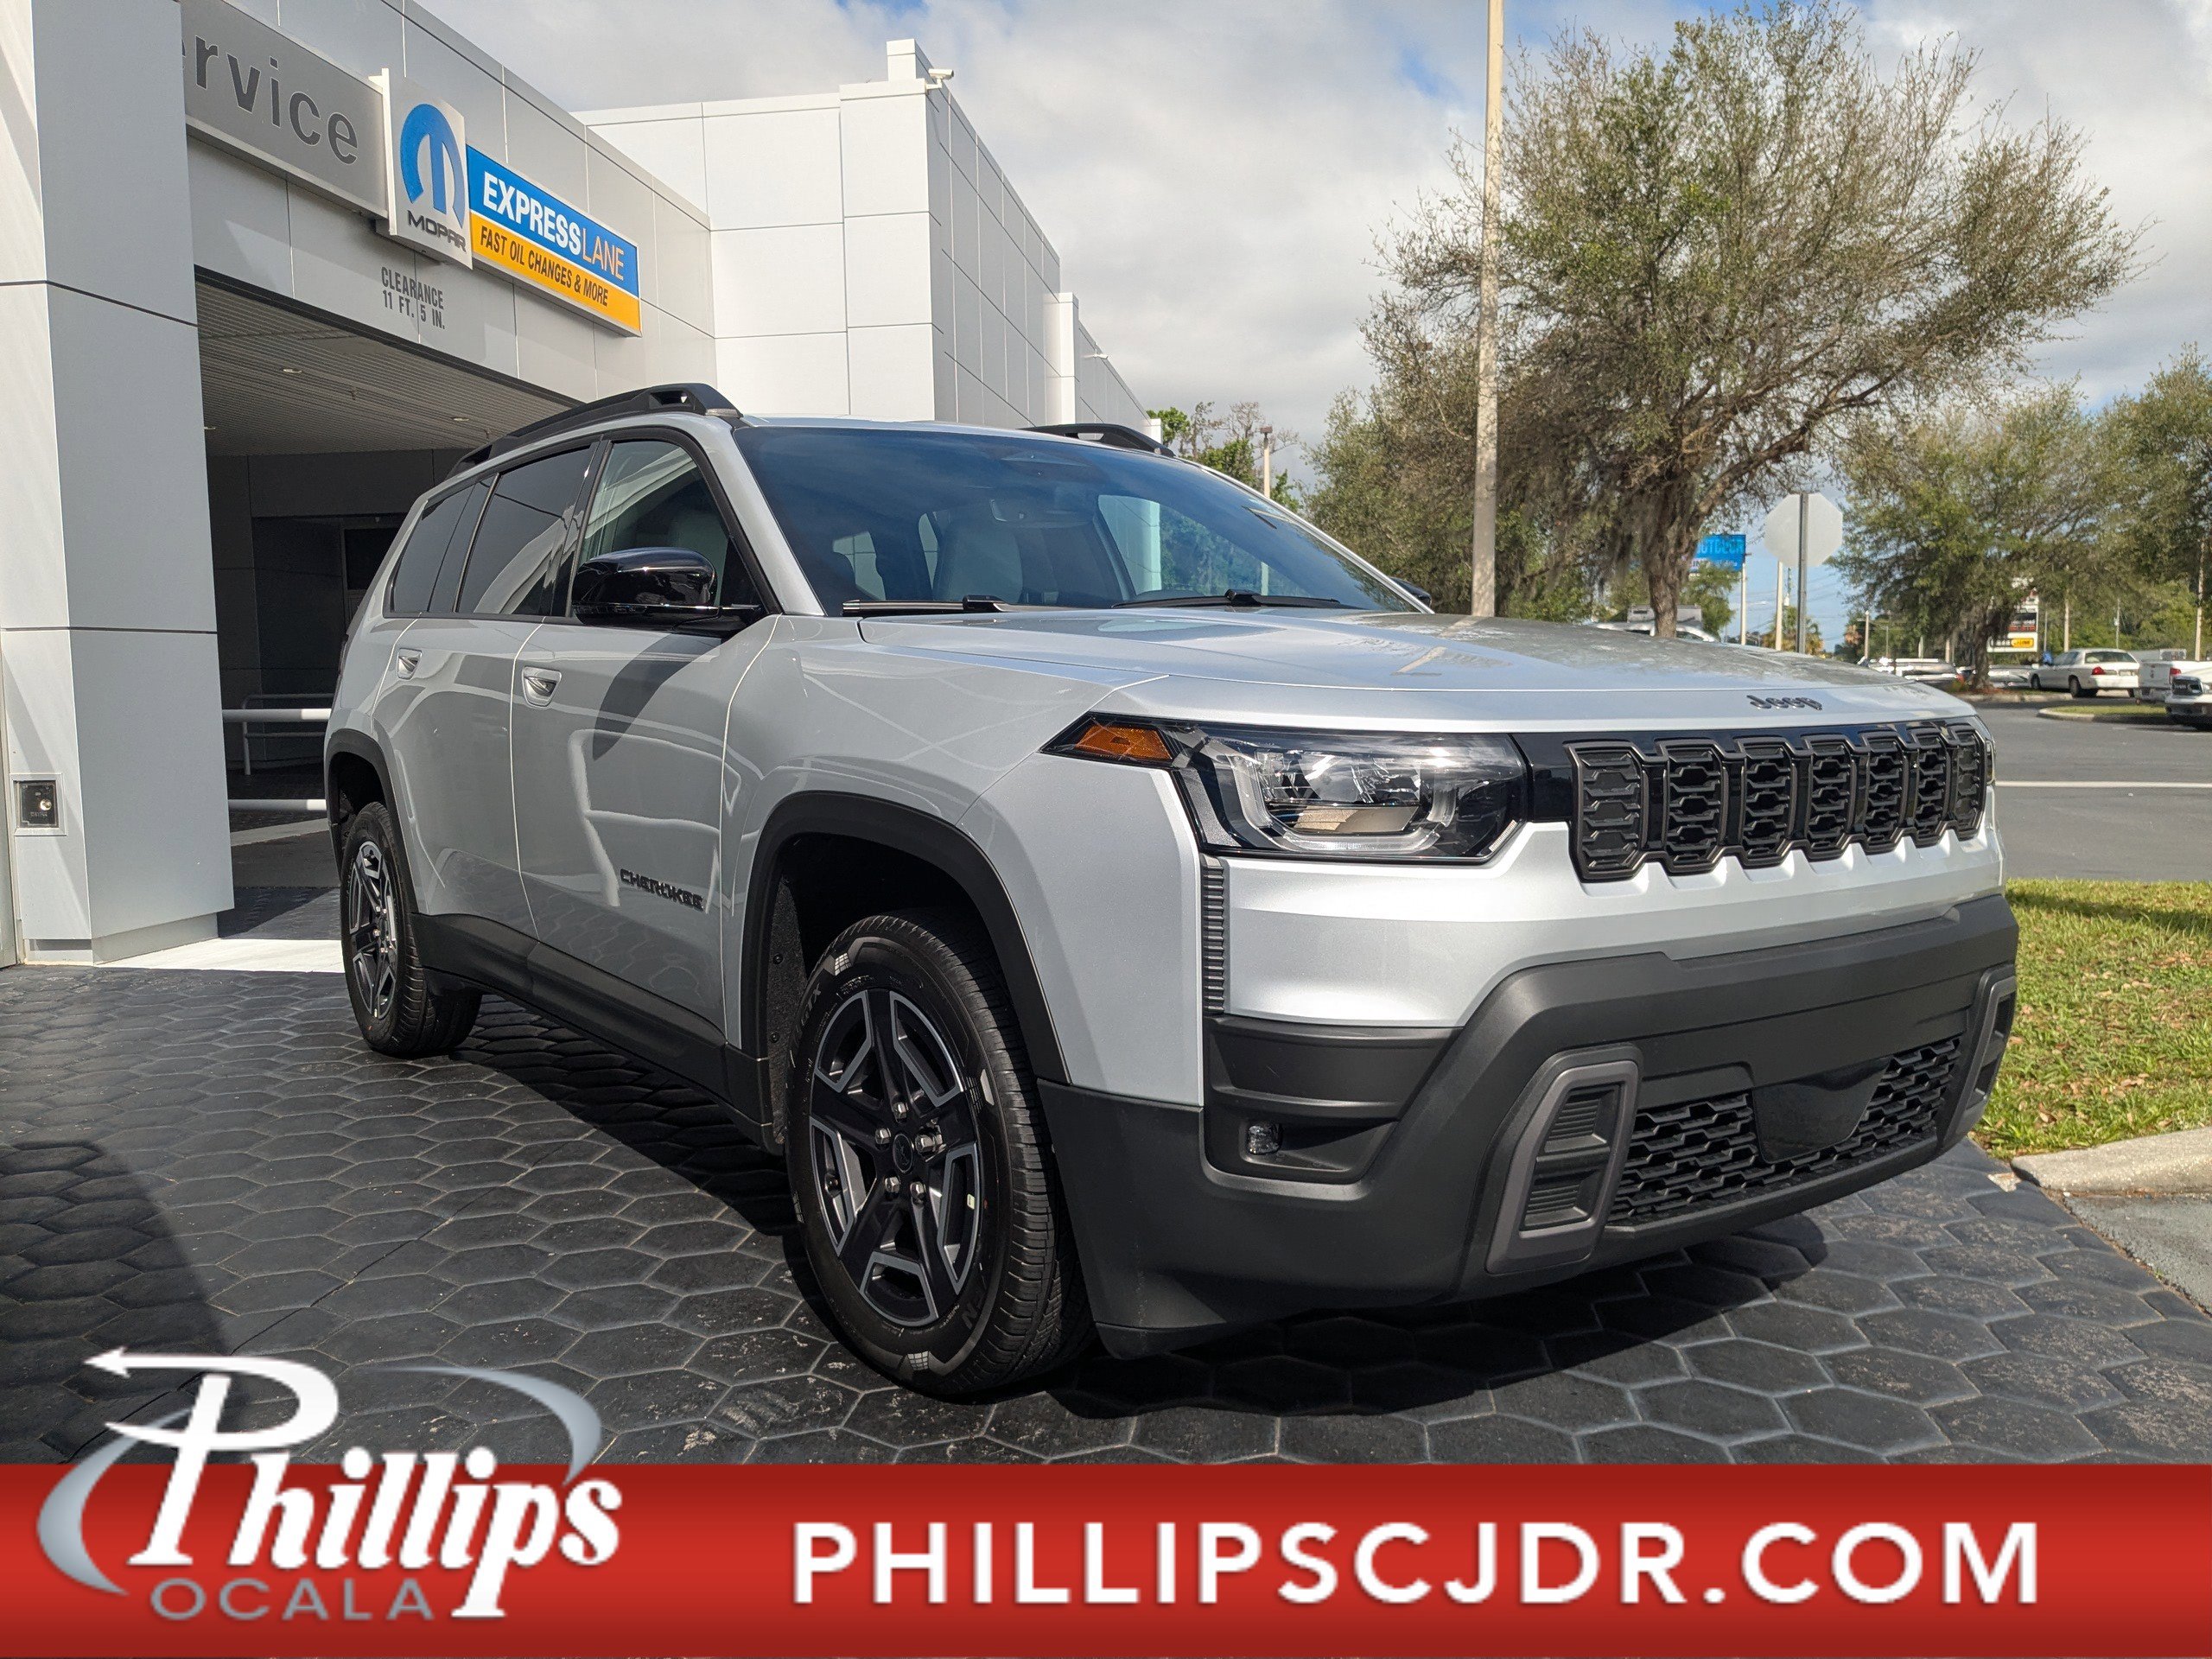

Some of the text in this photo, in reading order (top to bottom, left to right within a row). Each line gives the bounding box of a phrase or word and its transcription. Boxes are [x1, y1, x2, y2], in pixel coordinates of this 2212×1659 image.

[181, 35, 358, 165] rvice
[407, 209, 467, 252] MOPAR
[381, 266, 444, 310] CLEARANCE
[480, 226, 608, 307] FAST OIL CHANGES & MORE
[383, 289, 445, 330] 11 FT. 5 IN.
[1746, 695, 1822, 710] Jeep
[620, 868, 704, 912] CHEROKEE
